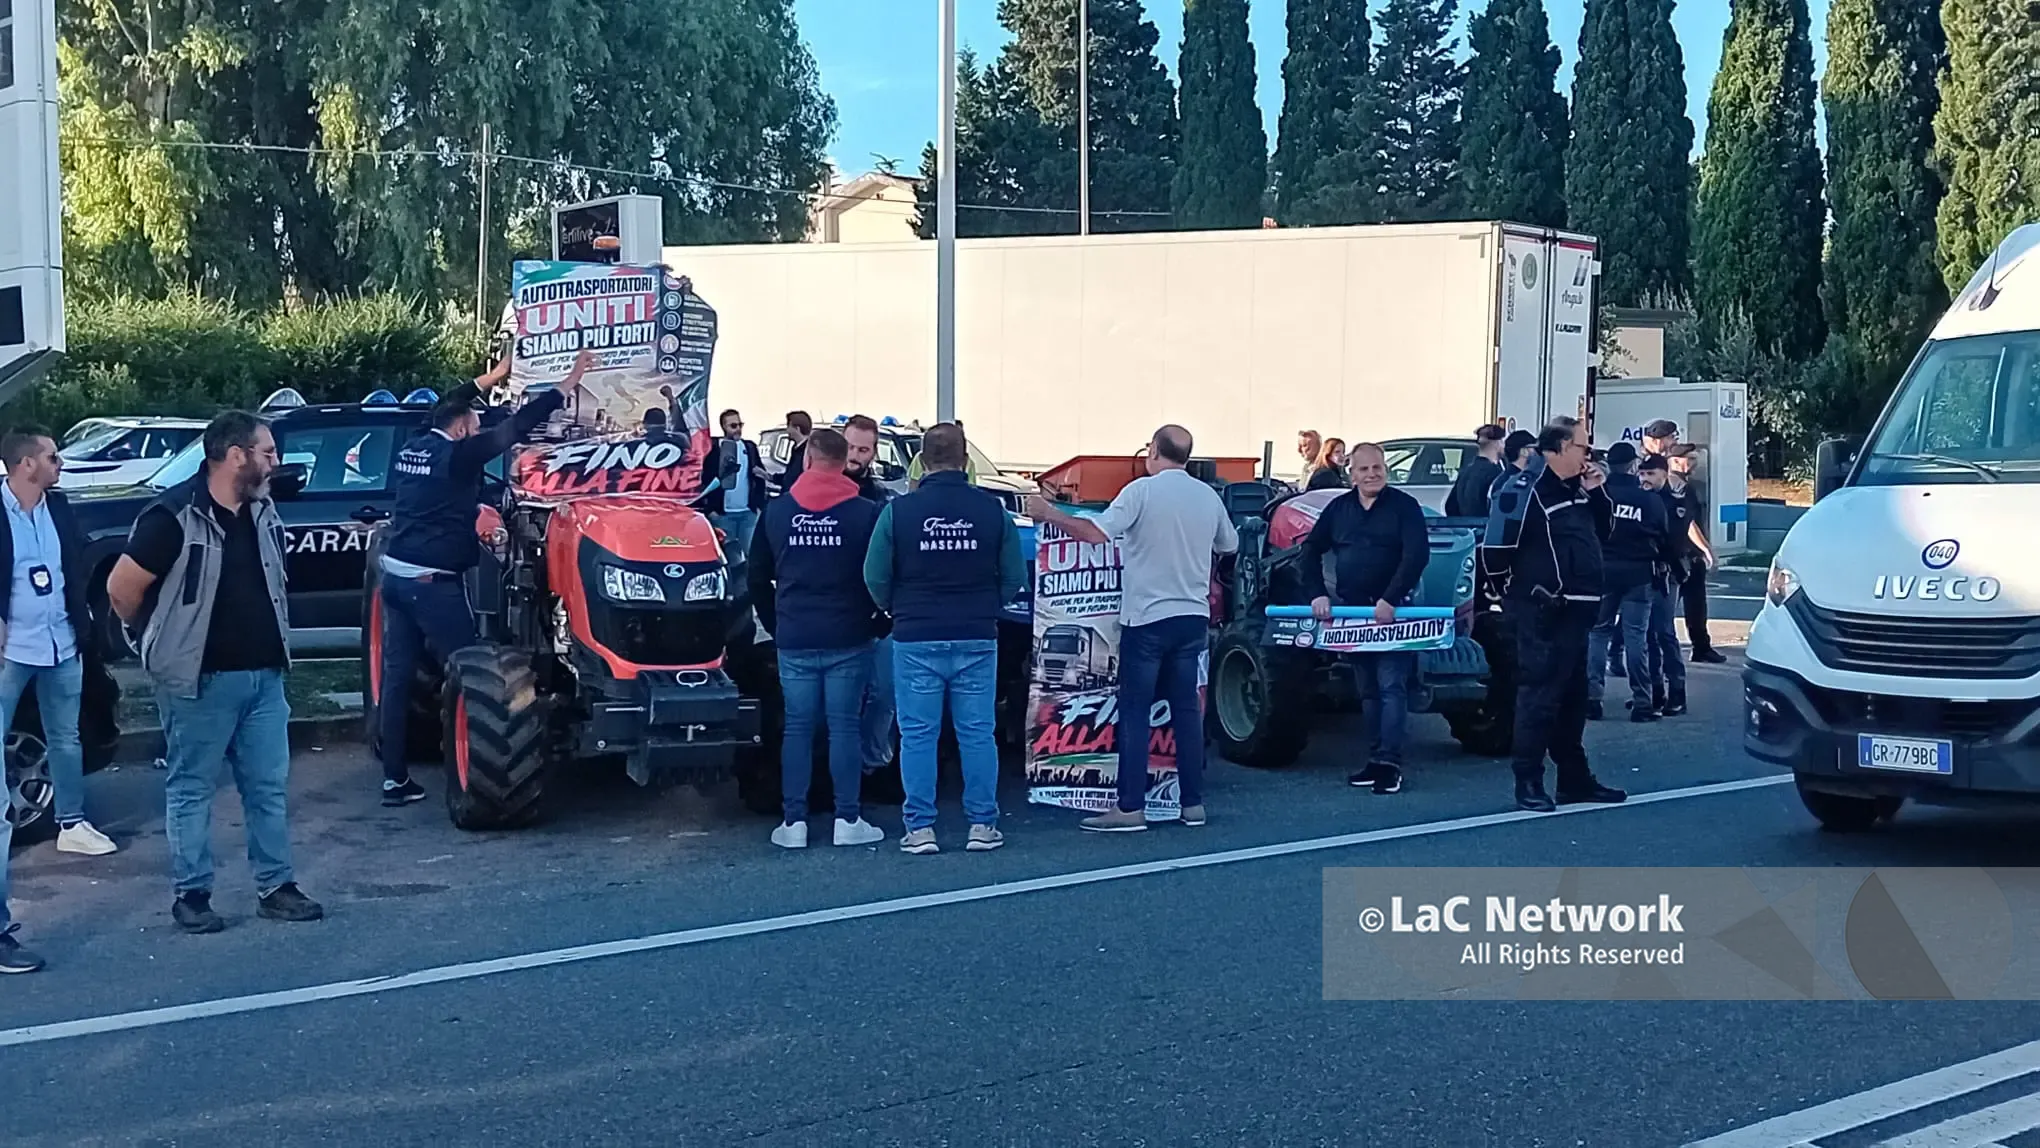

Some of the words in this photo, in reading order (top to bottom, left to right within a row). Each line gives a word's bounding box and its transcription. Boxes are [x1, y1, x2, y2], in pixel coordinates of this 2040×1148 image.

[521, 277, 653, 306] AUTOTRASPORTATORI
[526, 295, 646, 334] UNITI
[522, 330, 579, 357] SIAMO
[583, 325, 610, 348] PIÙ
[613, 321, 656, 345] FORTI
[543, 442, 682, 477] FINO
[522, 470, 609, 495] ALLA
[617, 466, 703, 492] FINE
[1613, 504, 1642, 522] IZIA
[284, 529, 376, 553] CARA
[789, 536, 841, 546] MASCARO
[920, 539, 978, 551] MASCARO
[1928, 545, 1954, 560] 040
[1047, 540, 1123, 571] UNI
[1044, 571, 1091, 595] SIAMO
[1095, 567, 1118, 590] PIÙ
[1873, 575, 2001, 602] IVECO
[1323, 619, 1445, 645] AUTOTRASPORTATORI
[1033, 723, 1115, 753] ALLA
